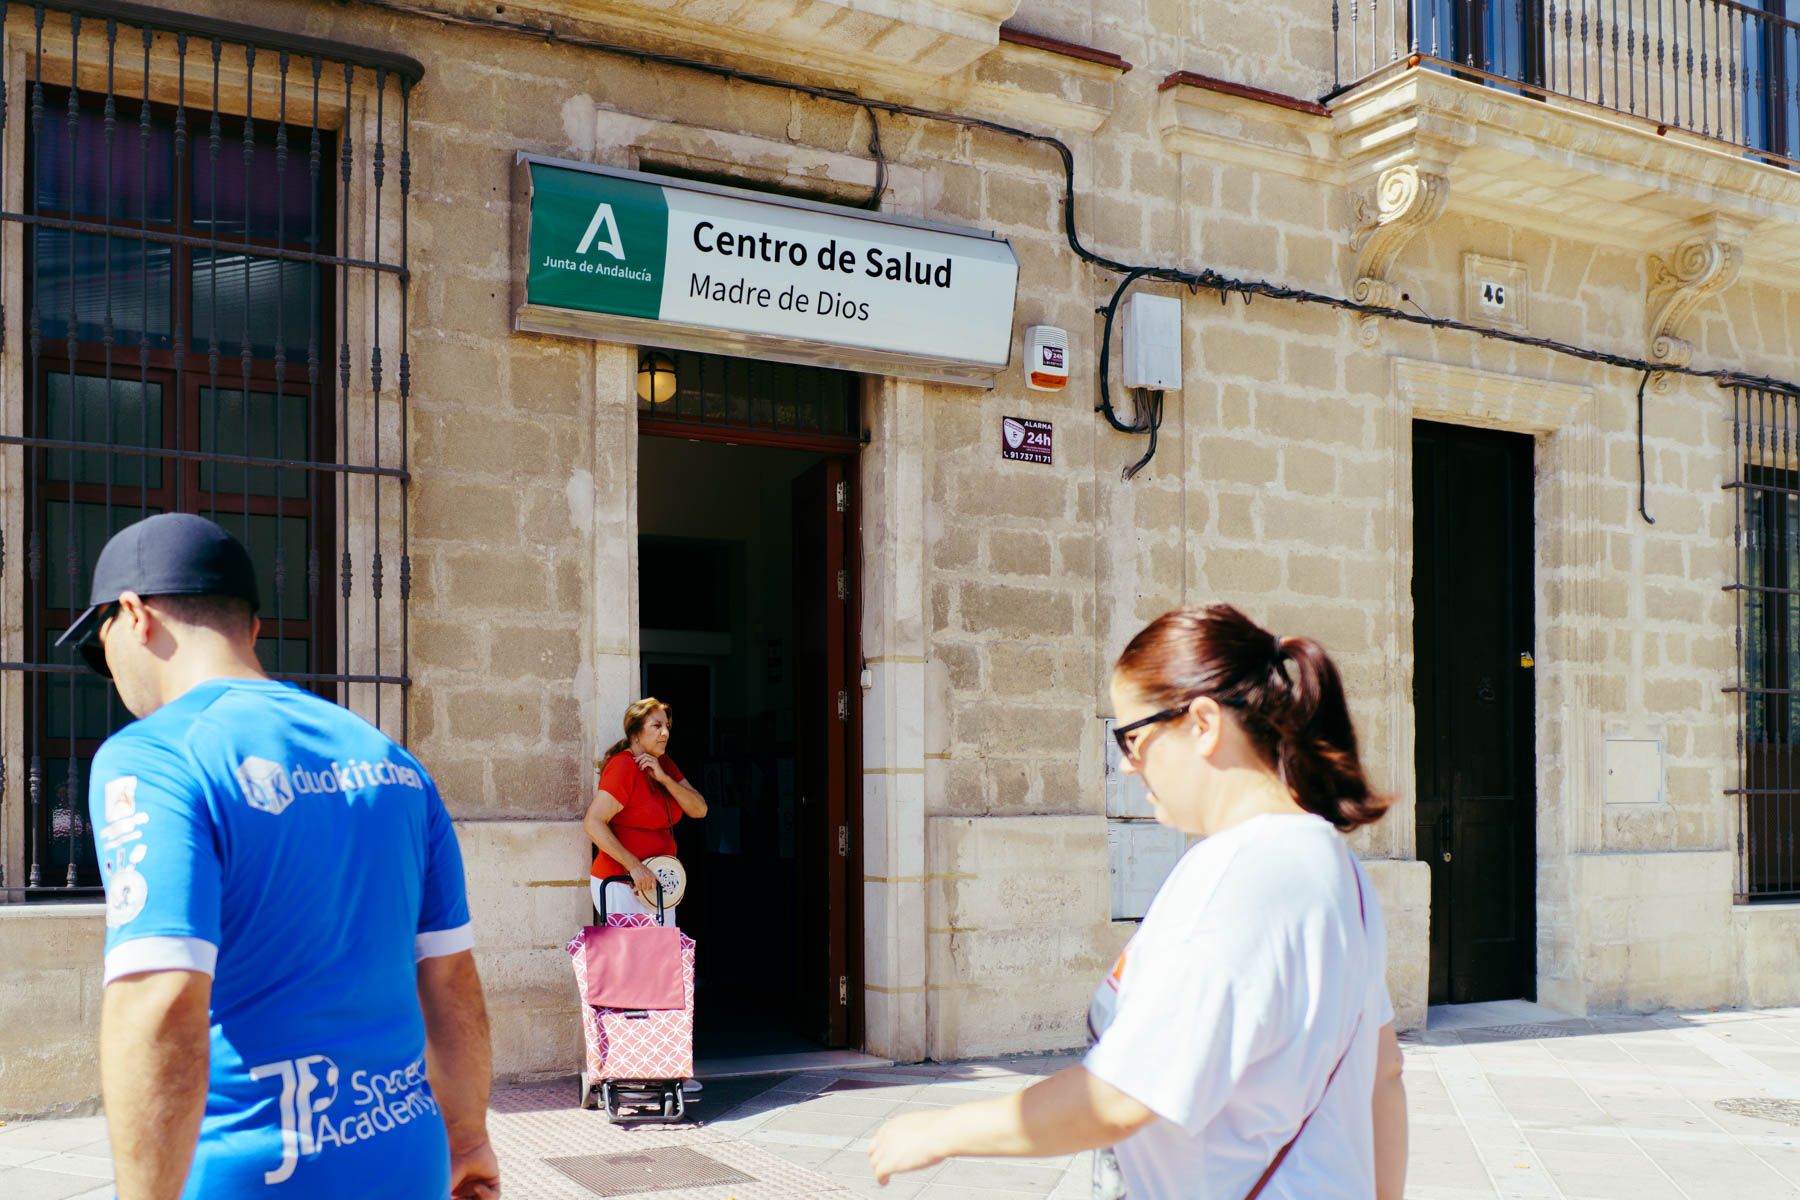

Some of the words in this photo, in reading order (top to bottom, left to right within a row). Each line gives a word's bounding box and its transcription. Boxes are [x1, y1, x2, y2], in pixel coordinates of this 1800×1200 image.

[693, 221, 807, 267] Centro
[817, 239, 856, 273] de
[865, 248, 953, 289] Salud
[543, 256, 576, 271] Junta
[579, 261, 593, 273] de
[595, 263, 652, 282] Andalucía
[689, 272, 771, 308] Madre
[777, 284, 809, 313] de
[816, 291, 870, 321] Dios
[1484, 284, 1504, 305] 46
[1024, 421, 1052, 430] ALARMA
[1026, 432, 1051, 446] 24h
[1010, 451, 1019, 459] 91
[1020, 452, 1034, 461] 737
[1042, 455, 1051, 463] 71
[291, 758, 424, 794] duokitchen
[315, 1088, 438, 1152] Academy
